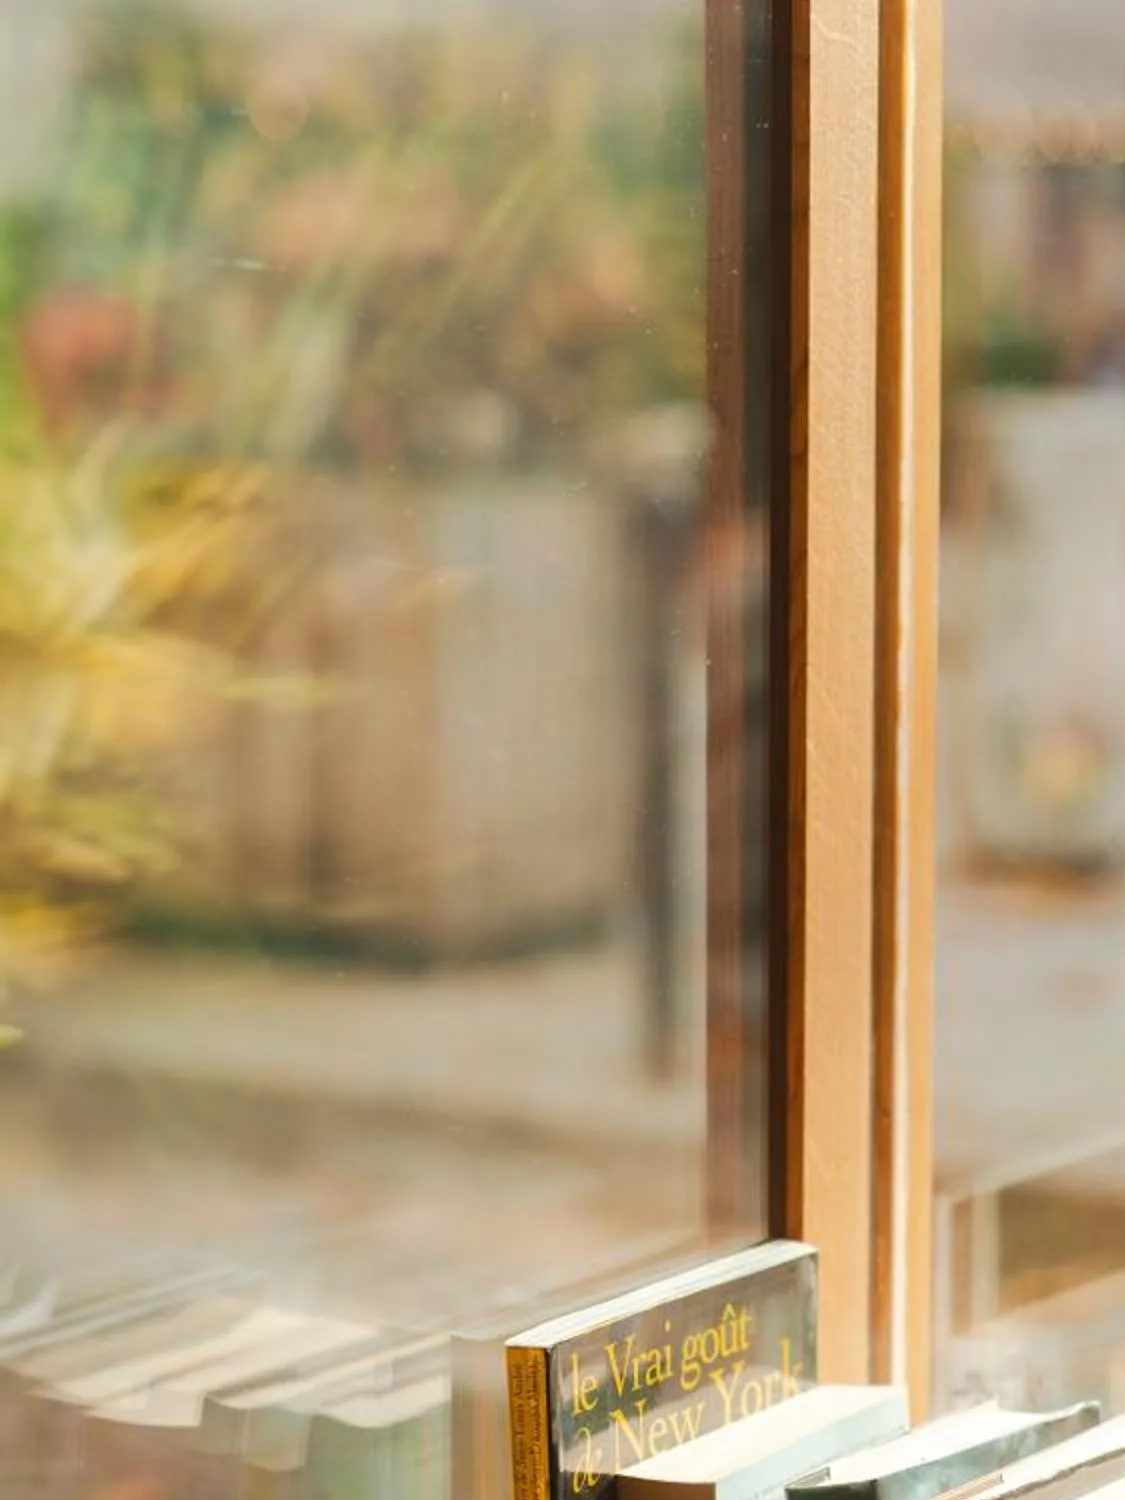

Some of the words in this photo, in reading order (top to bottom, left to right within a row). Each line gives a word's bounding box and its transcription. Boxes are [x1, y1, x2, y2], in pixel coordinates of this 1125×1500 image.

[571, 1354, 599, 1417] le
[605, 1320, 673, 1400] Vrai
[681, 1303, 752, 1390] goût
[610, 1398, 708, 1475] New
[707, 1338, 803, 1427] York
